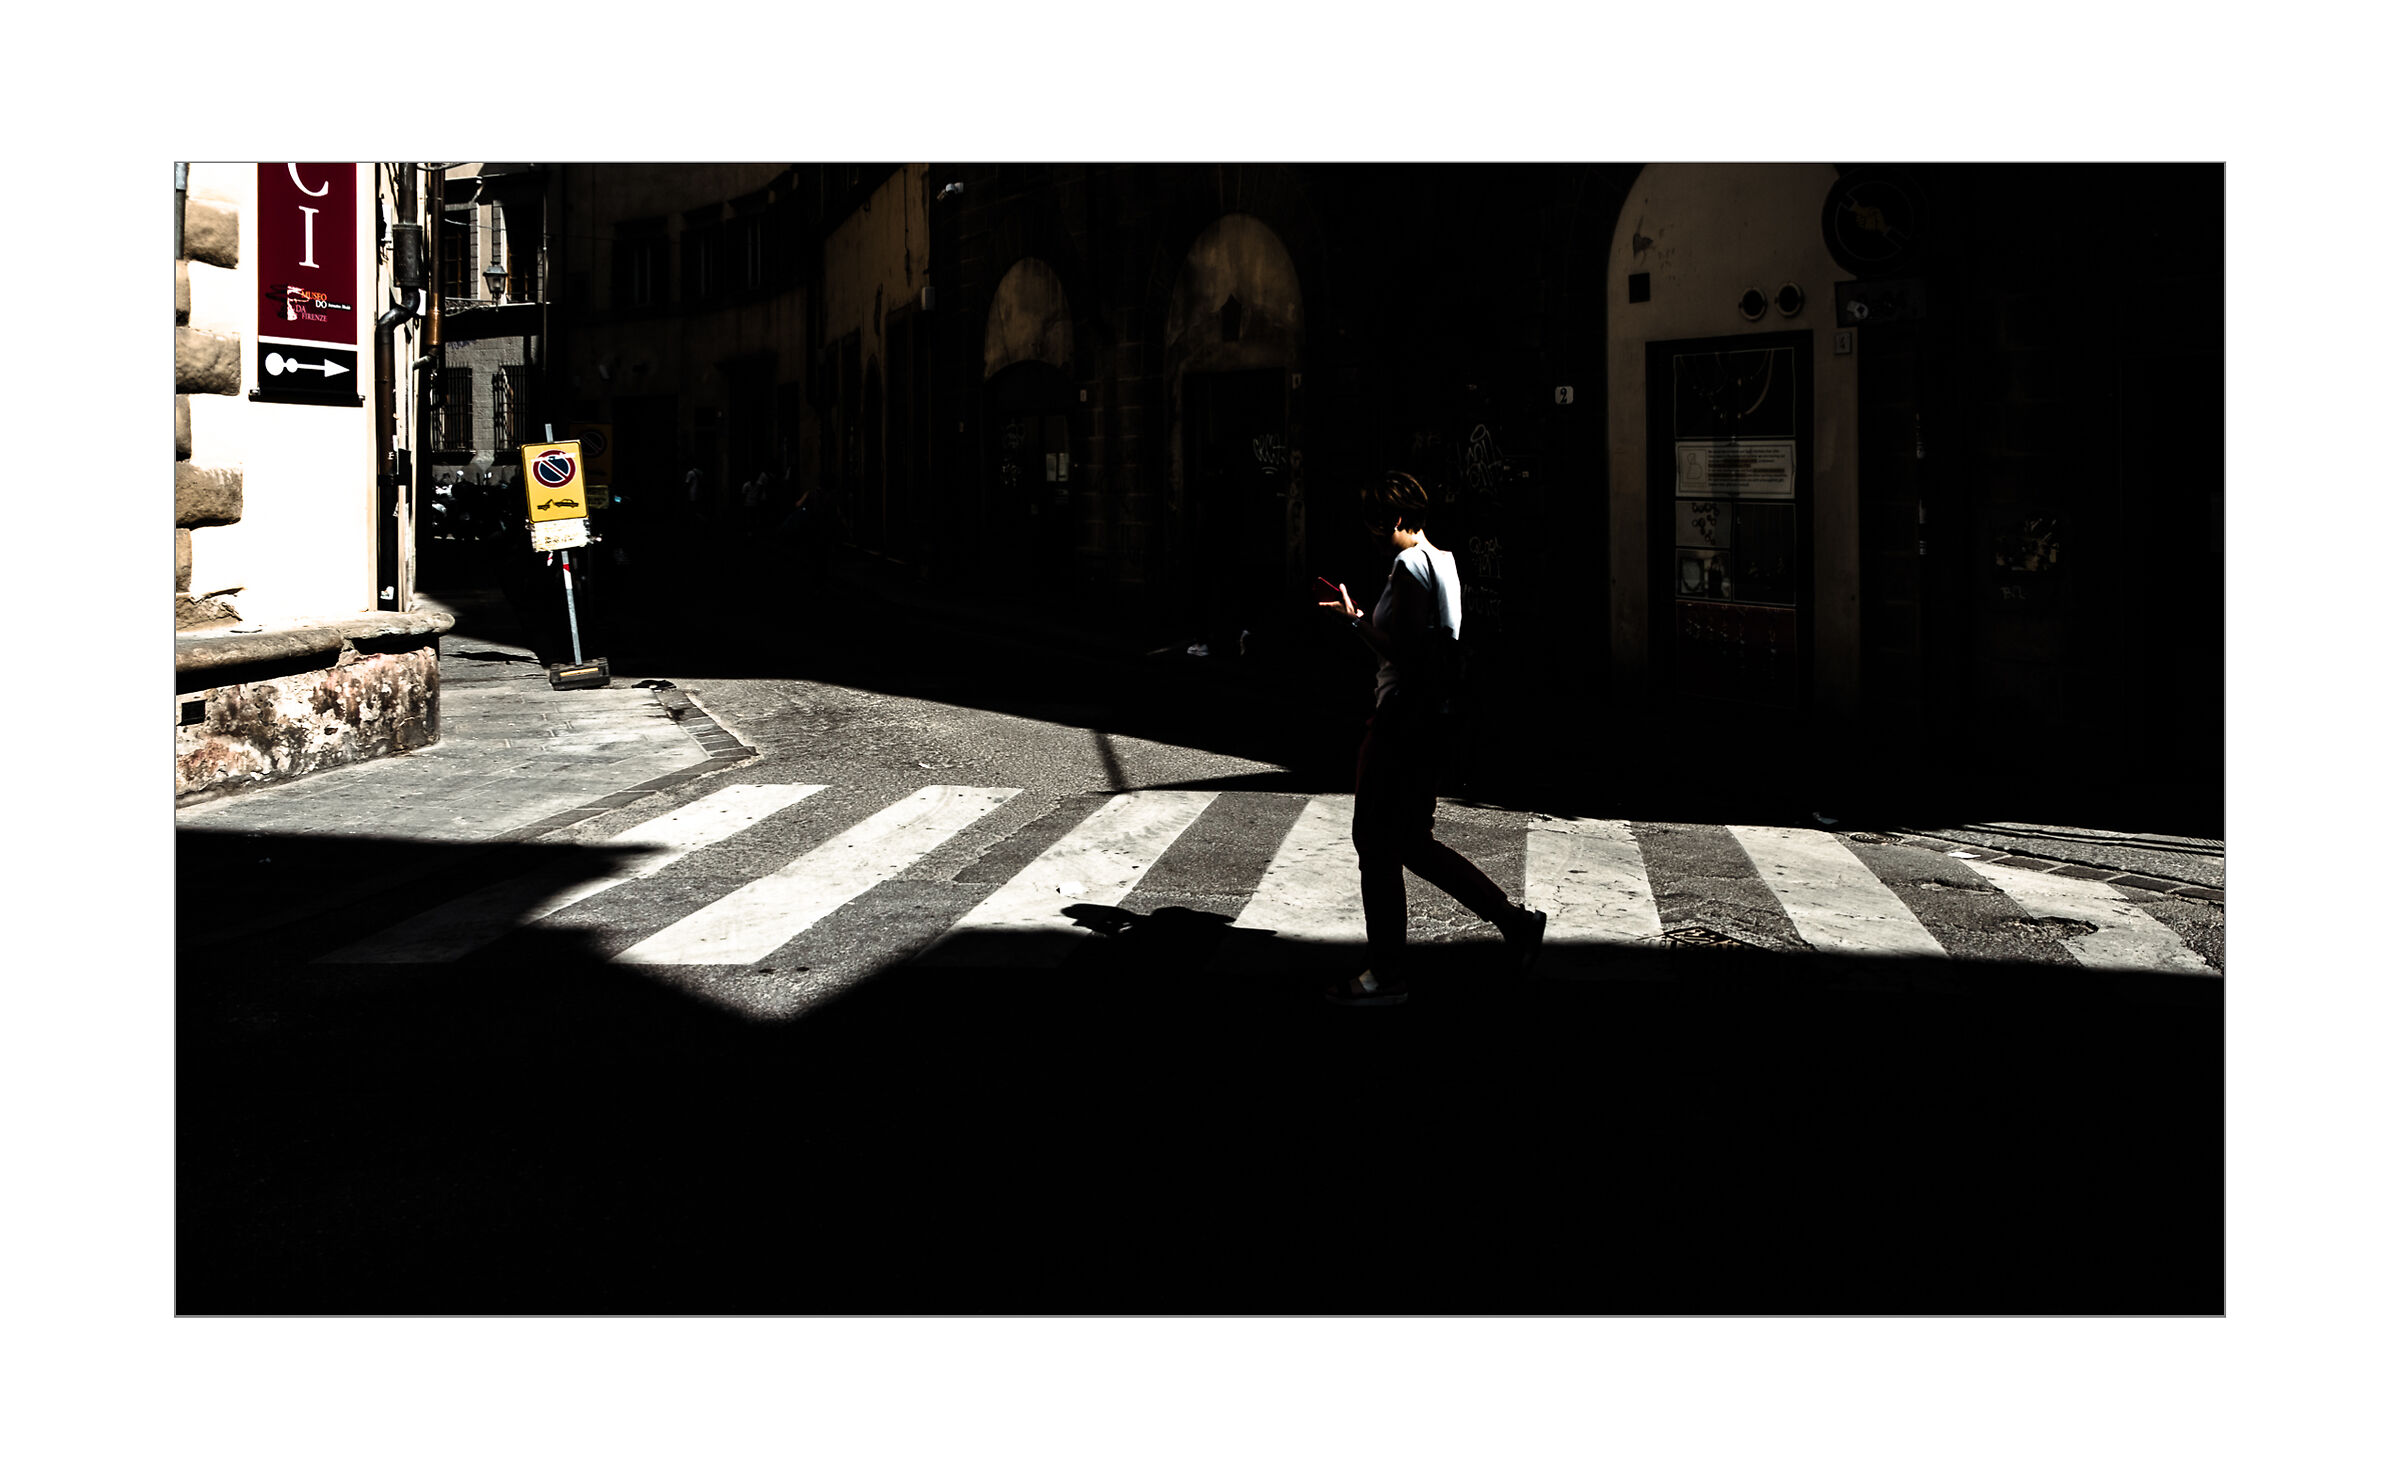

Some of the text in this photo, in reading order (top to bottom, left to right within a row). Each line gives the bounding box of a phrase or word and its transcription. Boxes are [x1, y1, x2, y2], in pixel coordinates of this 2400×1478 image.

[301, 290, 327, 301] MUSEO
[295, 305, 306, 313] DA
[315, 300, 328, 309] DO
[302, 312, 328, 322] FIRENZE
[1560, 388, 1567, 404] 2
